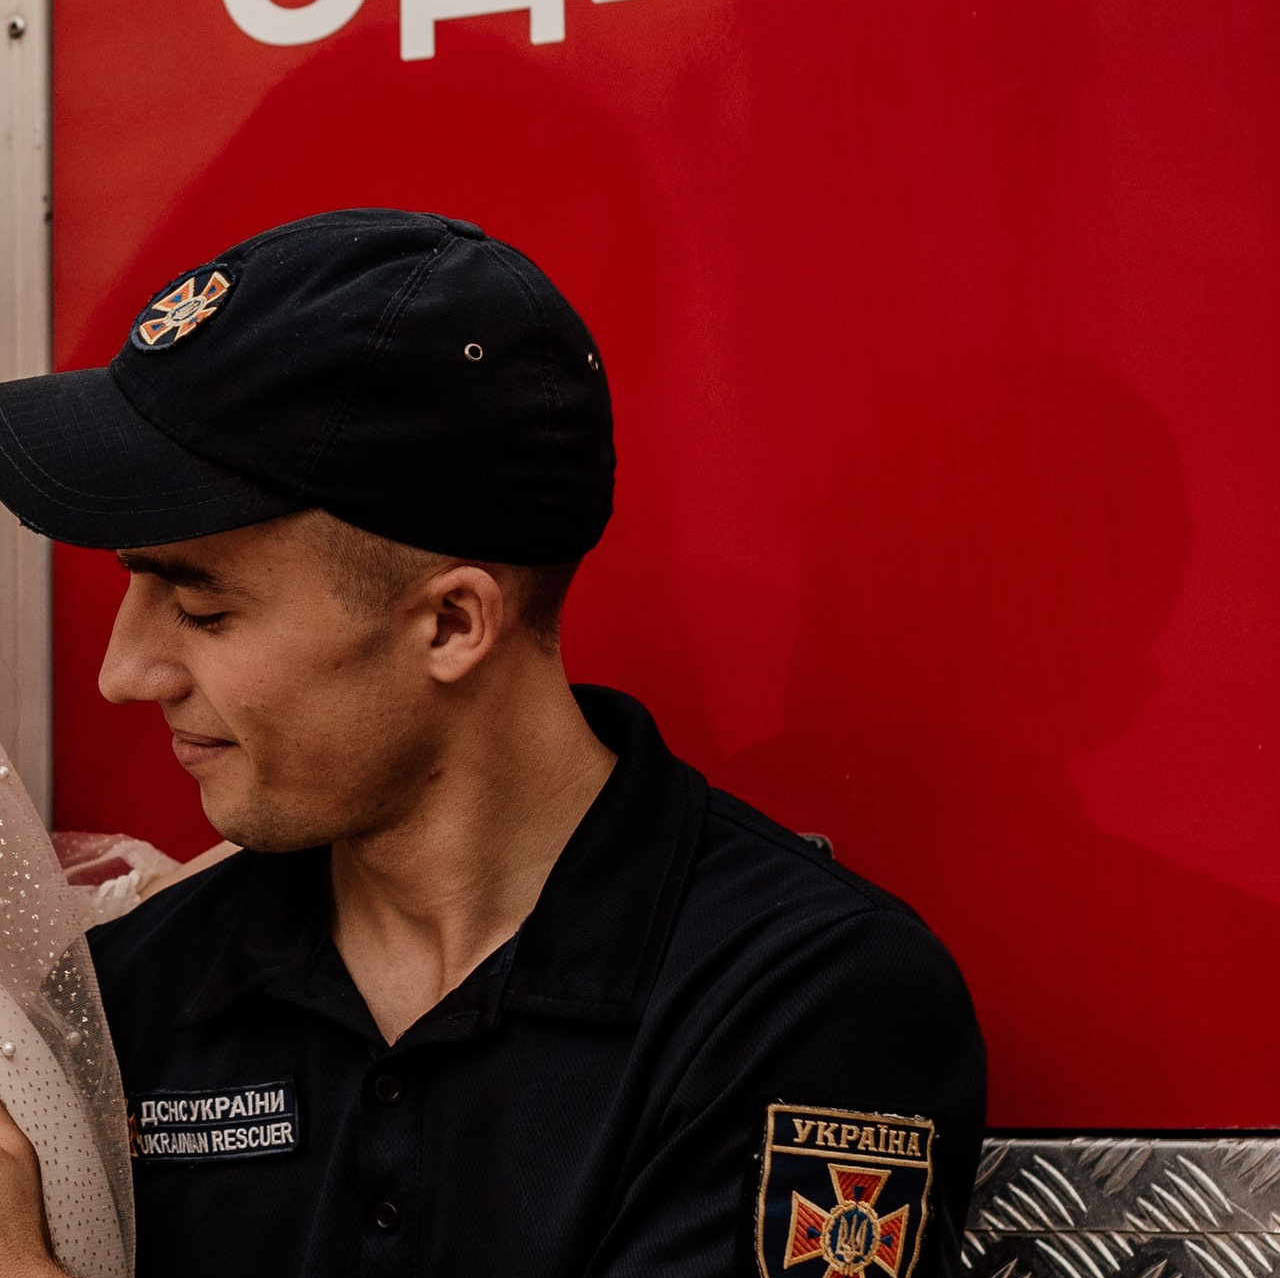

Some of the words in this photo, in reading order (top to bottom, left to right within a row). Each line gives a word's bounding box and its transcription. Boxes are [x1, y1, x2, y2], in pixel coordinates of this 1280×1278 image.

[139, 1132, 210, 1155] UKRAINIAN
[211, 1122, 294, 1152] RESCUER
[792, 1118, 921, 1156] УКРАЇНА
